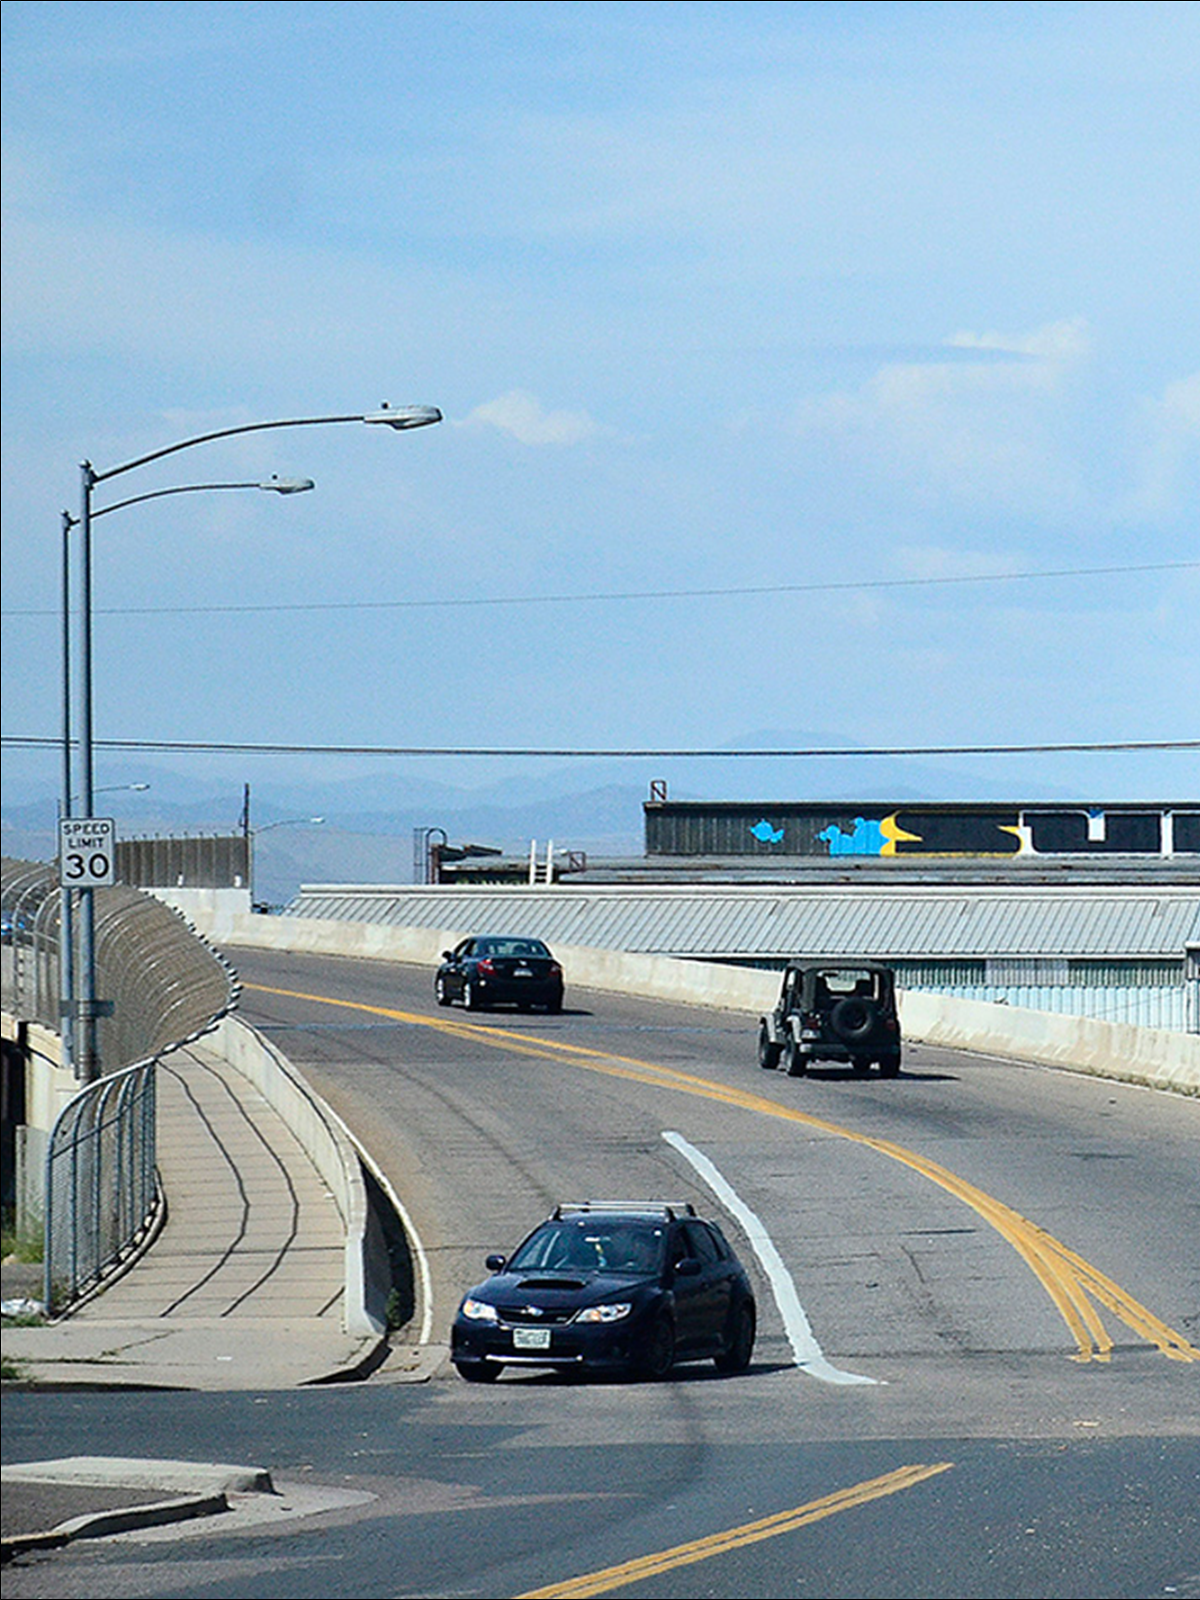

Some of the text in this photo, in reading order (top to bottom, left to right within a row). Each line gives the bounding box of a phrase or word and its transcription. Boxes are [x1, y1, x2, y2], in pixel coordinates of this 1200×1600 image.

[63, 823, 110, 835] SPEED
[68, 837, 104, 849] LIMIT
[66, 853, 109, 879] 30
